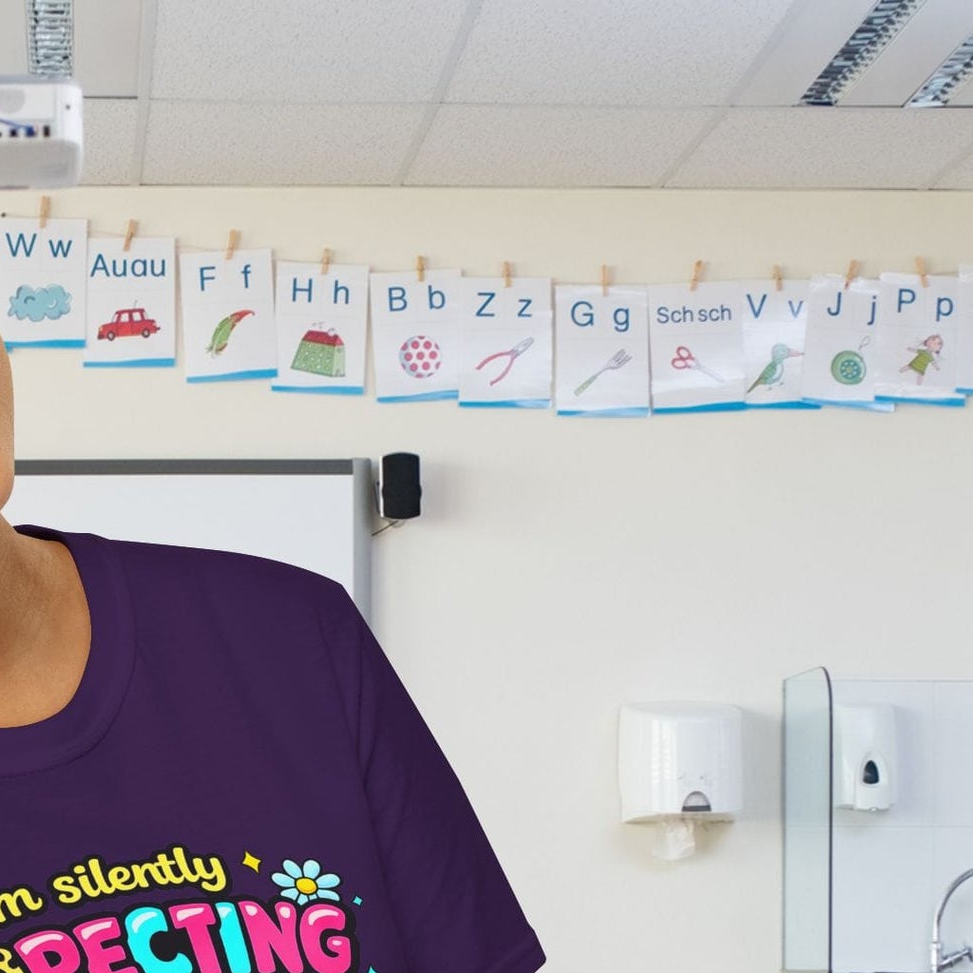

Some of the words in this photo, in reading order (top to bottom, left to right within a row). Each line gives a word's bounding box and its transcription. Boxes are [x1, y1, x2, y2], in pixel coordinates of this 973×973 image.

[5, 232, 37, 258] W
[48, 239, 73, 258] w
[199, 265, 216, 292] F
[241, 264, 252, 289] f
[291, 277, 313, 303] H
[333, 279, 350, 305] h
[388, 286, 408, 312] B
[427, 284, 446, 310] b
[475, 292, 496, 317] Z
[517, 298, 532, 318] z
[746, 293, 768, 319] V
[787, 299, 804, 318] v
[826, 291, 842, 317] J
[867, 295, 877, 326] j
[897, 288, 916, 313] P
[936, 297, 954, 322] p
[570, 300, 594, 327] G
[613, 307, 630, 333] g
[53, 847, 227, 904] silently
